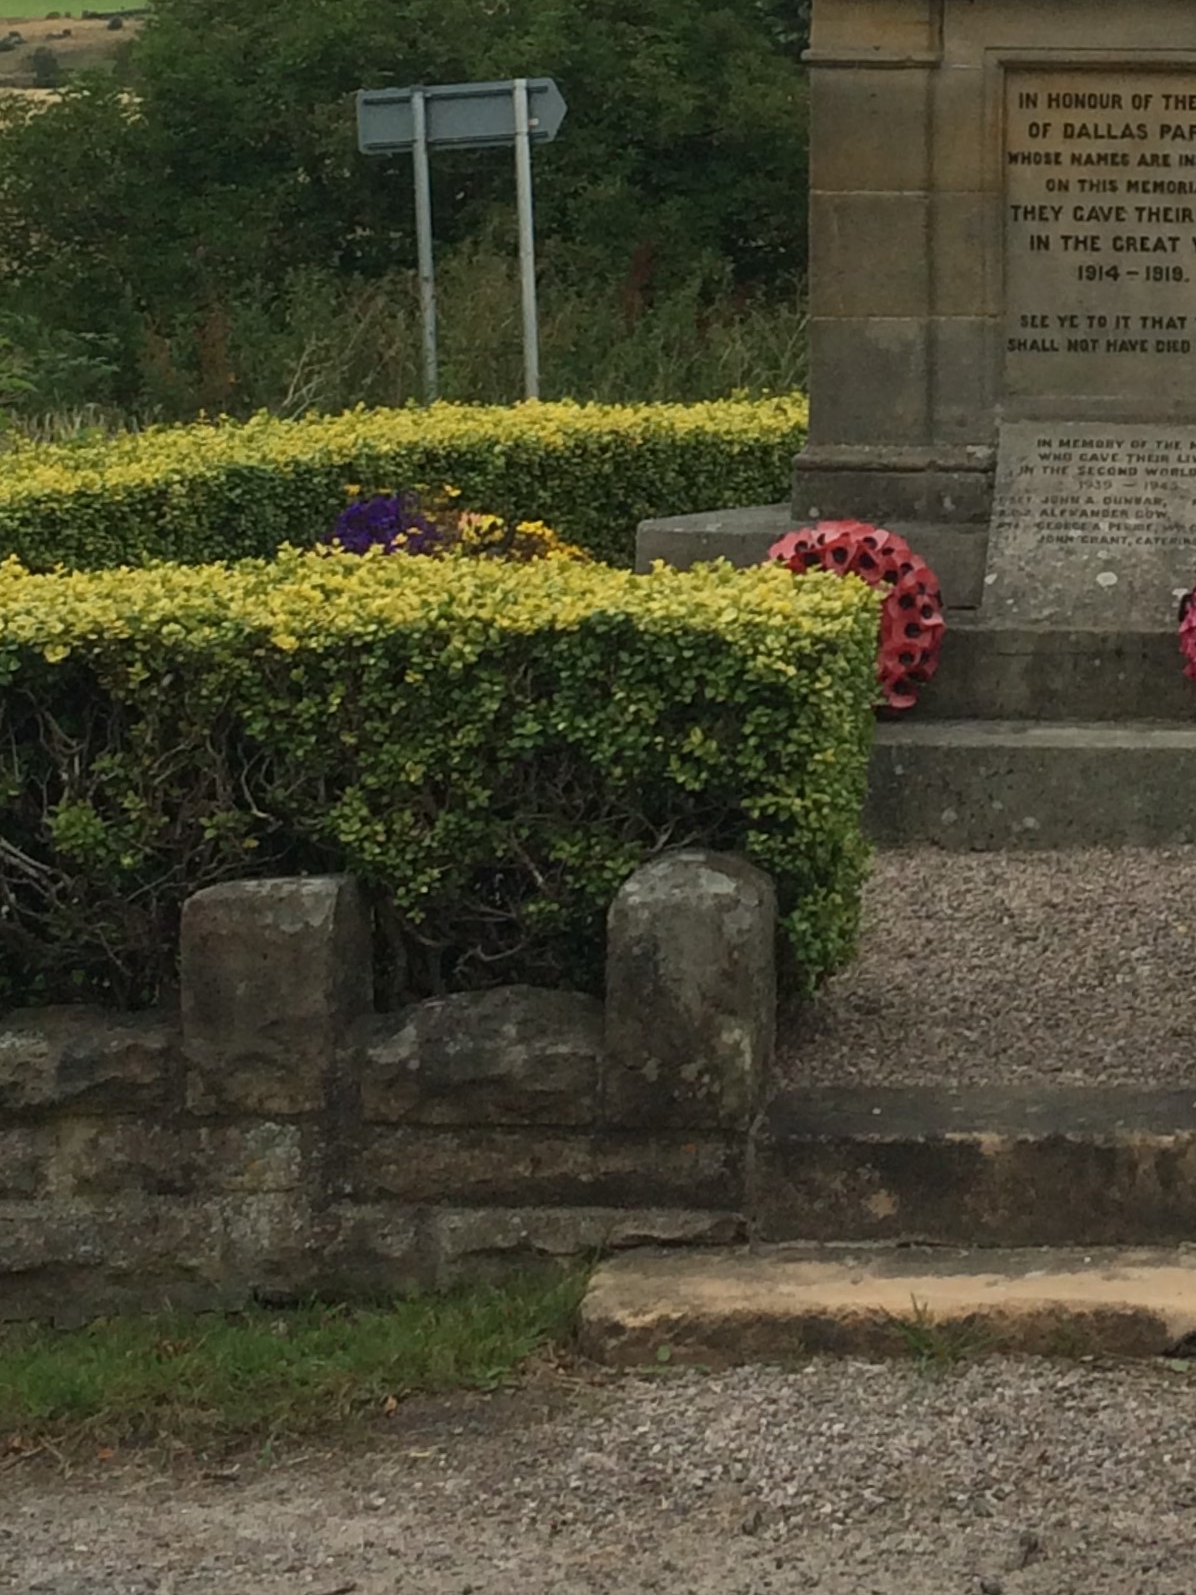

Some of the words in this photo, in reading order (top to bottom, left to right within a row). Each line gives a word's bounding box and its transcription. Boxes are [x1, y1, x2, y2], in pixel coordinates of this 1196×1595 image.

[1018, 93, 1039, 109] IN
[1047, 93, 1123, 111] HONOUR
[1131, 94, 1153, 111] OF
[1027, 122, 1052, 140] OF
[1063, 124, 1149, 141] DALLAS
[1007, 152, 1063, 166] WHOSE
[1070, 153, 1130, 168] NAMES
[1136, 154, 1172, 169] ARE
[1045, 179, 1070, 193] ON
[1077, 179, 1119, 194] THIS
[1010, 206, 1064, 222] THEY
[1072, 206, 1127, 223] GAVE
[1134, 207, 1195, 224] THEIR
[1029, 235, 1050, 251] IN
[1060, 236, 1101, 252] THE
[1111, 236, 1181, 253] GREAT
[1077, 266, 1121, 282] 1914
[1019, 315, 1050, 329] SEE
[1056, 315, 1079, 329] YE
[1086, 316, 1108, 330] TO
[1115, 316, 1132, 330] IT
[1139, 316, 1188, 331] THAT
[1007, 339, 1060, 353] SHALL
[1067, 340, 1099, 353] NOT
[1105, 340, 1149, 353] HAVE
[1155, 340, 1191, 354] DIED
[1036, 438, 1053, 449] IN
[1058, 438, 1125, 450] MEMORY
[1129, 439, 1147, 450] OF
[1155, 439, 1182, 451] THE
[1038, 452, 1073, 462] WHO
[1078, 452, 1120, 463] GAVE
[1125, 452, 1170, 464] THEIR
[1041, 465, 1069, 476] THE
[1077, 465, 1139, 477] SECOND
